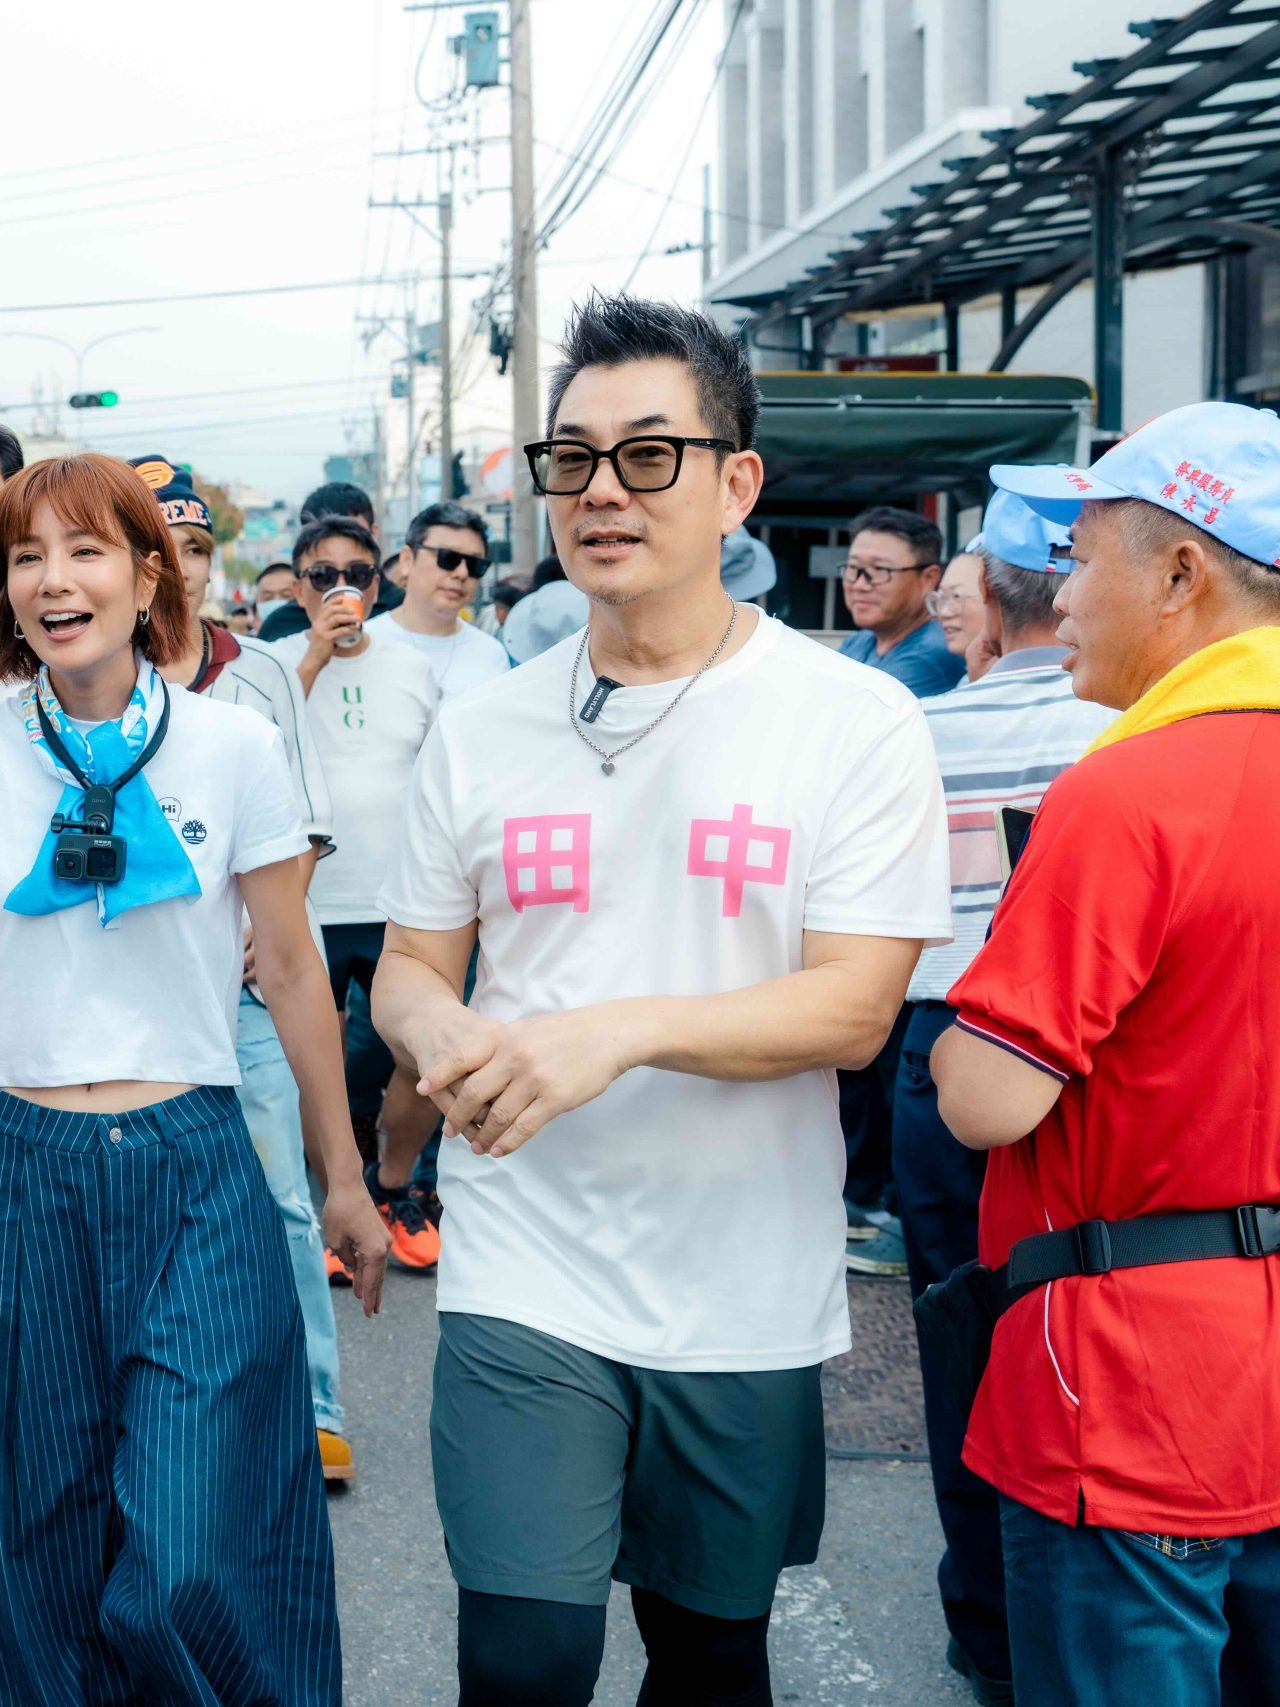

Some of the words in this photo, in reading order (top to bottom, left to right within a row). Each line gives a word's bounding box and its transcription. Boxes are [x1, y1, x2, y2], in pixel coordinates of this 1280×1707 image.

[157, 499, 208, 525] REME
[161, 804, 176, 814] Hi
[502, 813, 592, 914] 田
[687, 803, 791, 918] 中
